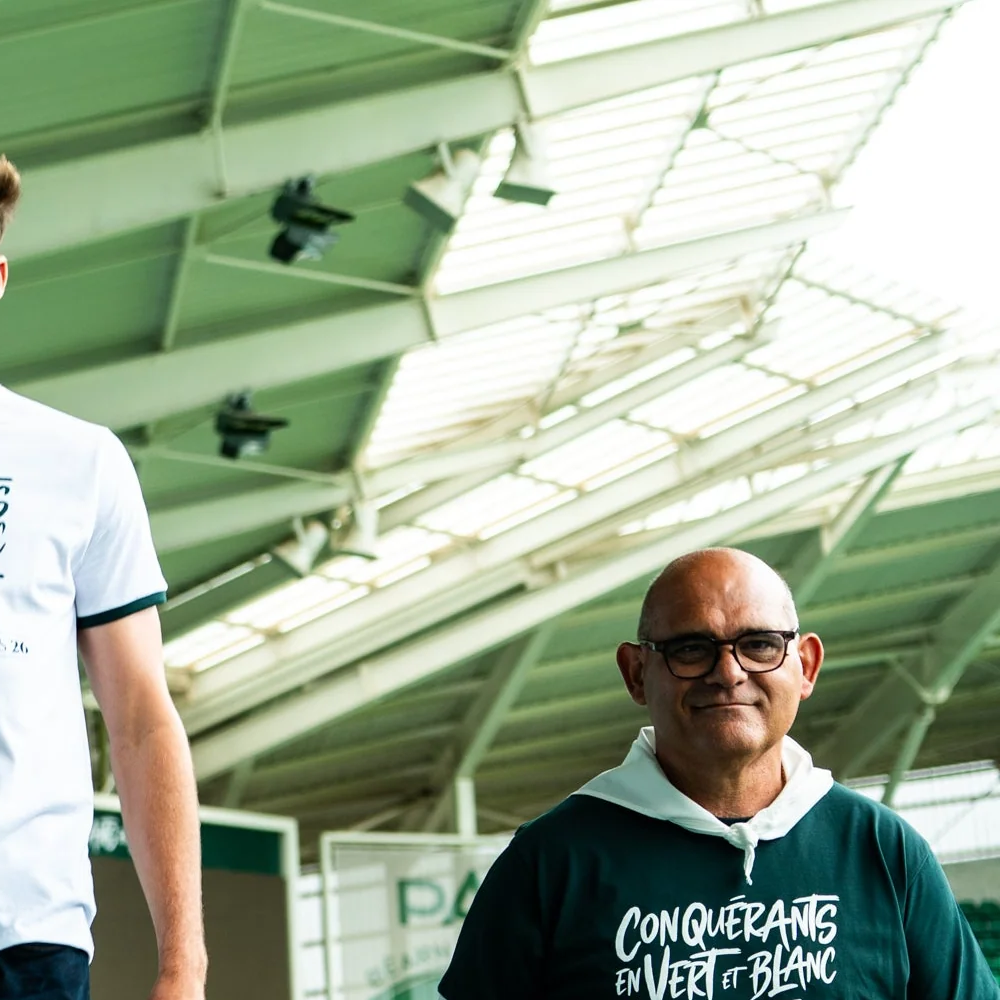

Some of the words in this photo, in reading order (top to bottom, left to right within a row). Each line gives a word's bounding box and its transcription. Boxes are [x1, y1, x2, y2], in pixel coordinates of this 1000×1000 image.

[11, 639, 29, 654] 26
[615, 893, 840, 962] CONQUÉRANTS
[615, 967, 641, 996] EN
[722, 966, 748, 990] ET
